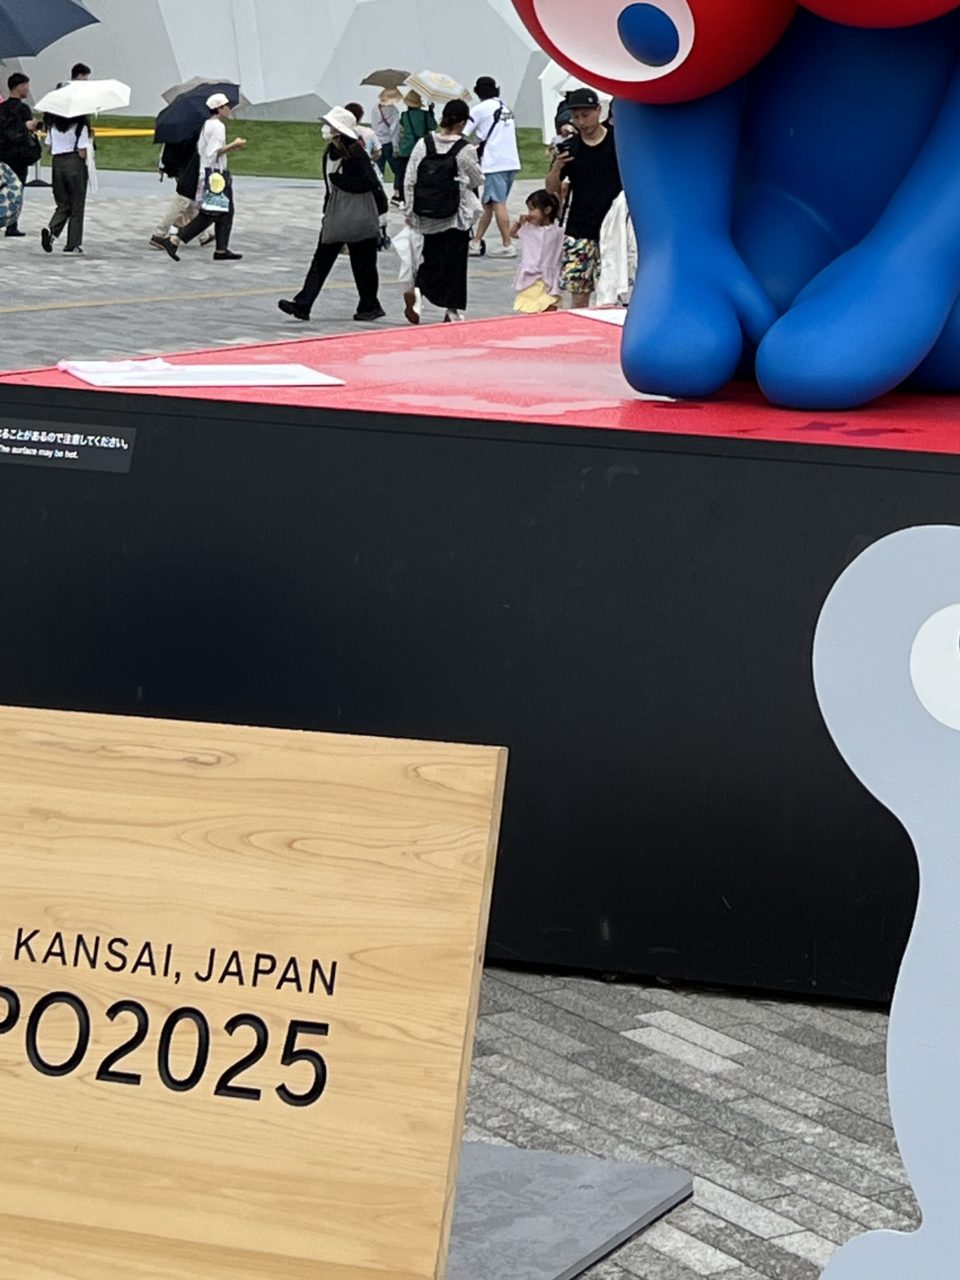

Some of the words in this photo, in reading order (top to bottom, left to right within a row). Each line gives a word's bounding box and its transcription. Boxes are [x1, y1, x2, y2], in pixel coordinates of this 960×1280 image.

[0, 428, 128, 450] ることがあるので注意してください。
[14, 927, 182, 985] KANSAI,
[194, 948, 338, 996] JAPAN
